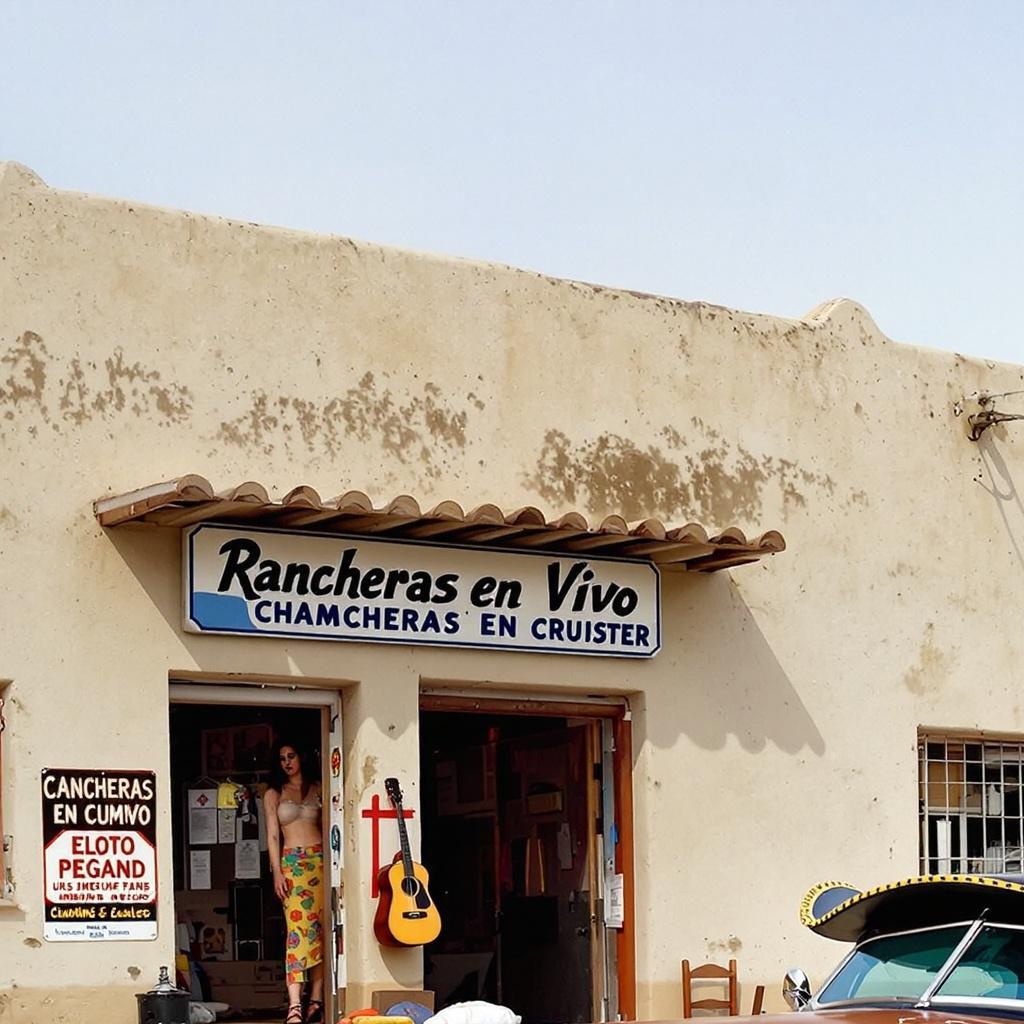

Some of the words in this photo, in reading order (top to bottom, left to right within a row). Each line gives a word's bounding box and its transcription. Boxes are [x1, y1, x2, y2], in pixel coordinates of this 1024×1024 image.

[217, 538, 459, 604] Rancheras
[470, 576, 522, 609] en
[547, 561, 638, 617] Vivo
[254, 600, 460, 634] CHAMCHERAS
[481, 613, 516, 637] EN
[531, 617, 650, 647] CRUISTER
[43, 775, 154, 800] CANCHERAS
[53, 804, 78, 824] EN
[72, 836, 135, 855] ELOTO
[59, 859, 146, 879] PEGAND
